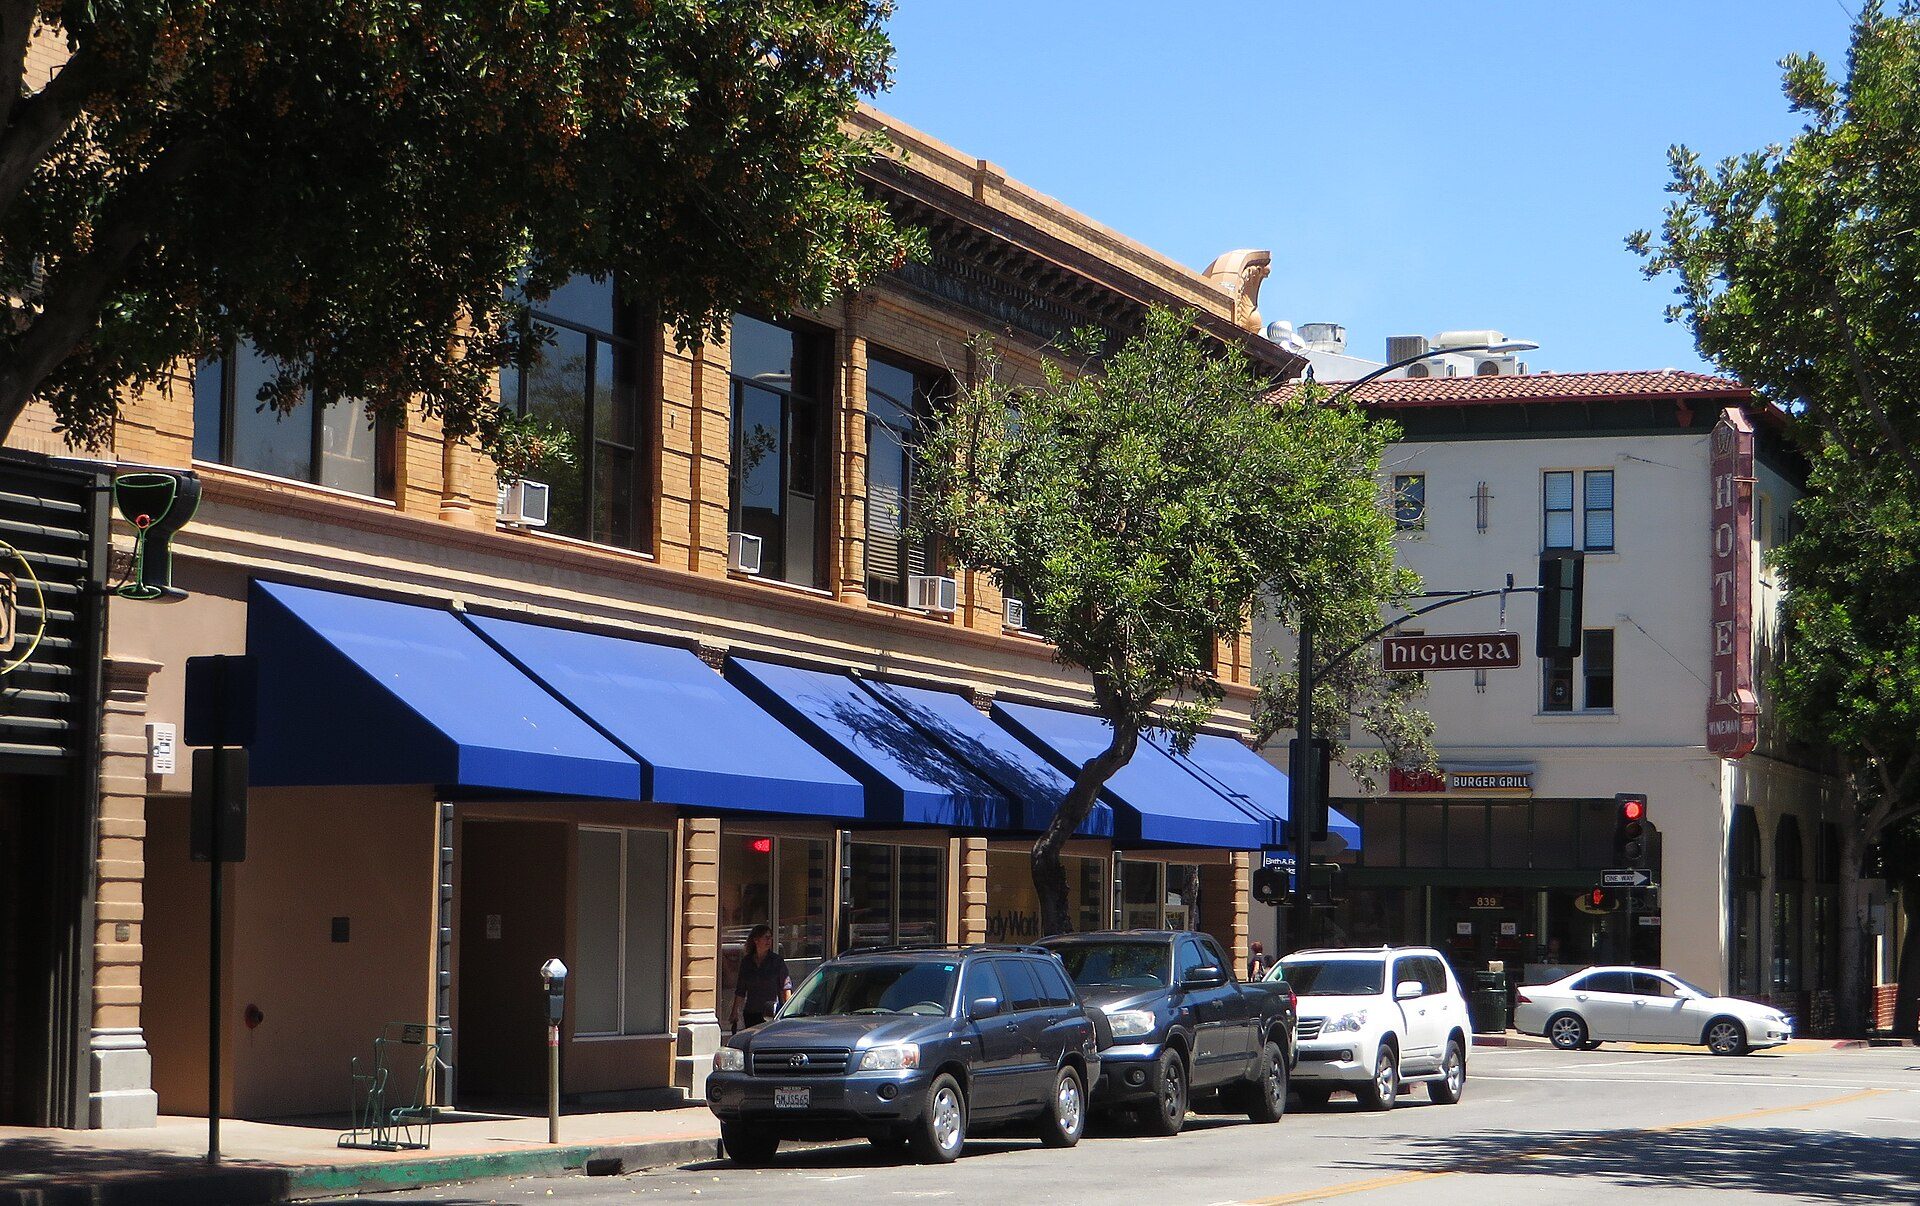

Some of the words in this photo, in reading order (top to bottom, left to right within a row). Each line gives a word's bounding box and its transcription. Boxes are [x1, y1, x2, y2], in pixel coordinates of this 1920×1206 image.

[1714, 474, 1733, 706] HOTEL
[1708, 719, 1739, 735] WINEMAN
[1453, 776, 1496, 787] BURGER
[1499, 776, 1528, 787] GRILL
[1476, 897, 1496, 906] 839
